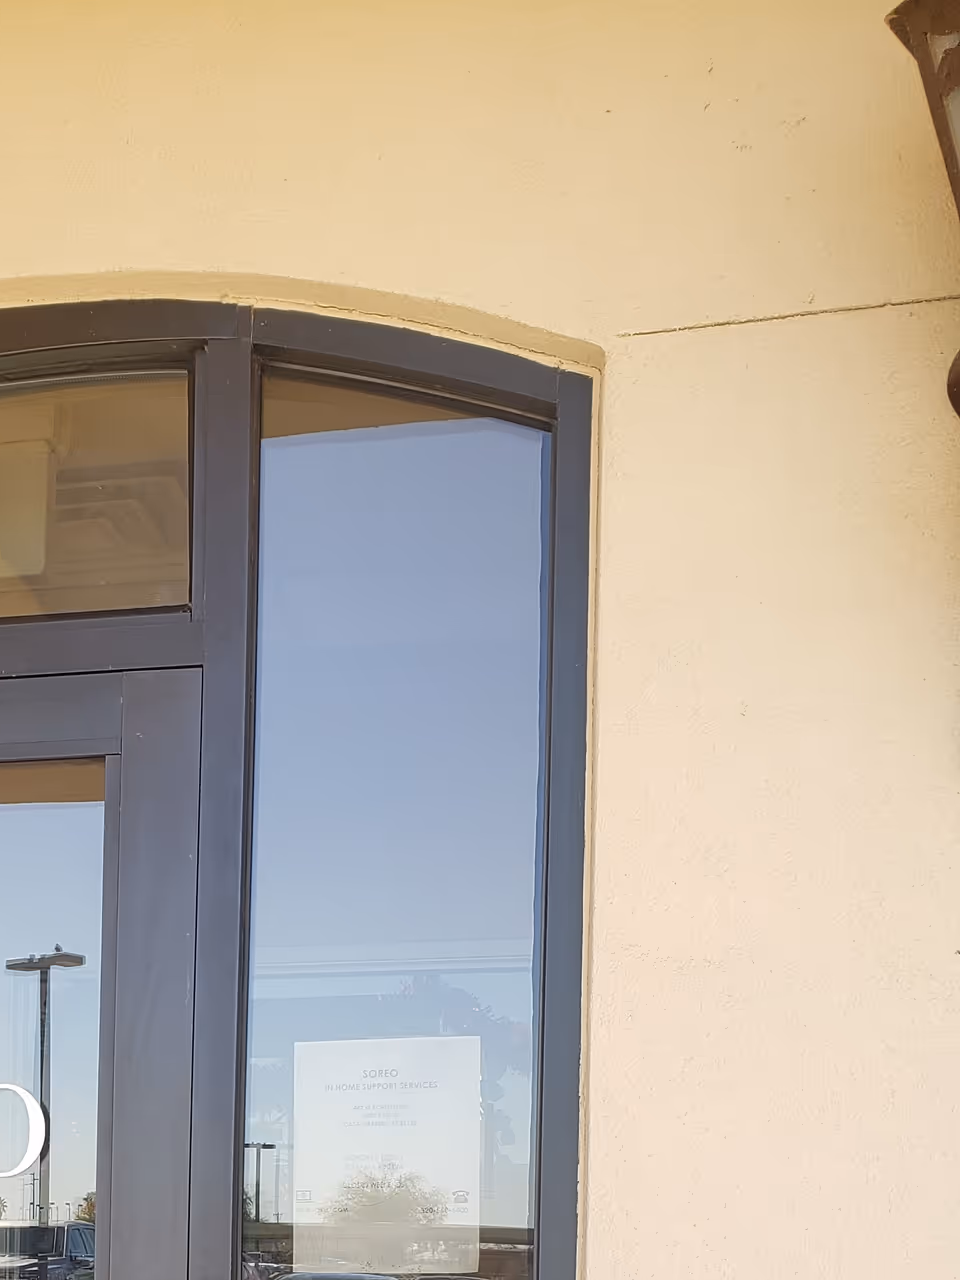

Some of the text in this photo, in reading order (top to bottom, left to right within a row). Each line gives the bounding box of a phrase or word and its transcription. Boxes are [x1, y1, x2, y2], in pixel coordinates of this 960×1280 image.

[363, 1068, 399, 1079] SOREO
[335, 1082, 360, 1091] HOME
[361, 1081, 398, 1091] SUPPORT
[399, 1080, 438, 1090] SERVICES
